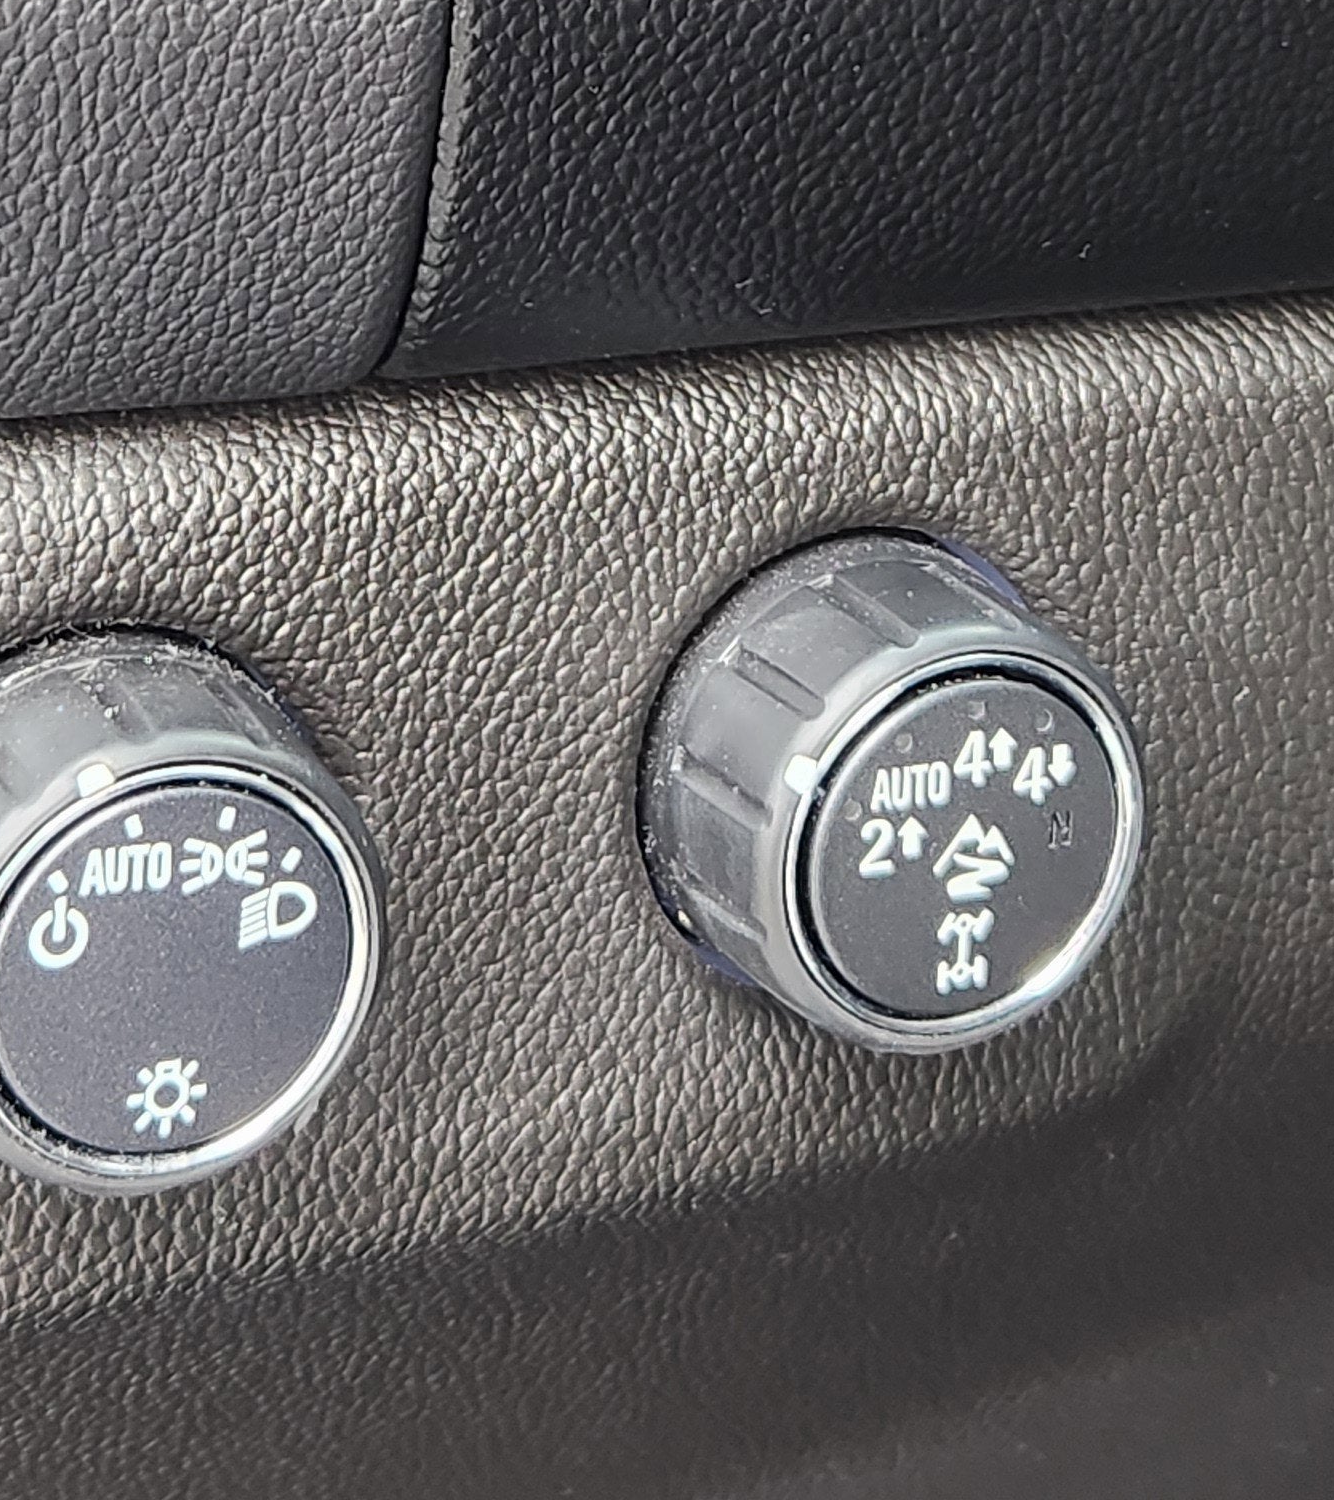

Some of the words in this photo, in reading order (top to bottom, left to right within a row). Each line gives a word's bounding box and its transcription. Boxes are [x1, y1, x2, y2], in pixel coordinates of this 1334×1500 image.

[871, 761, 952, 813] AUTO
[953, 729, 994, 788] 4
[1012, 745, 1053, 805] 4
[78, 841, 172, 898] AUTO
[858, 817, 896, 879] 2
